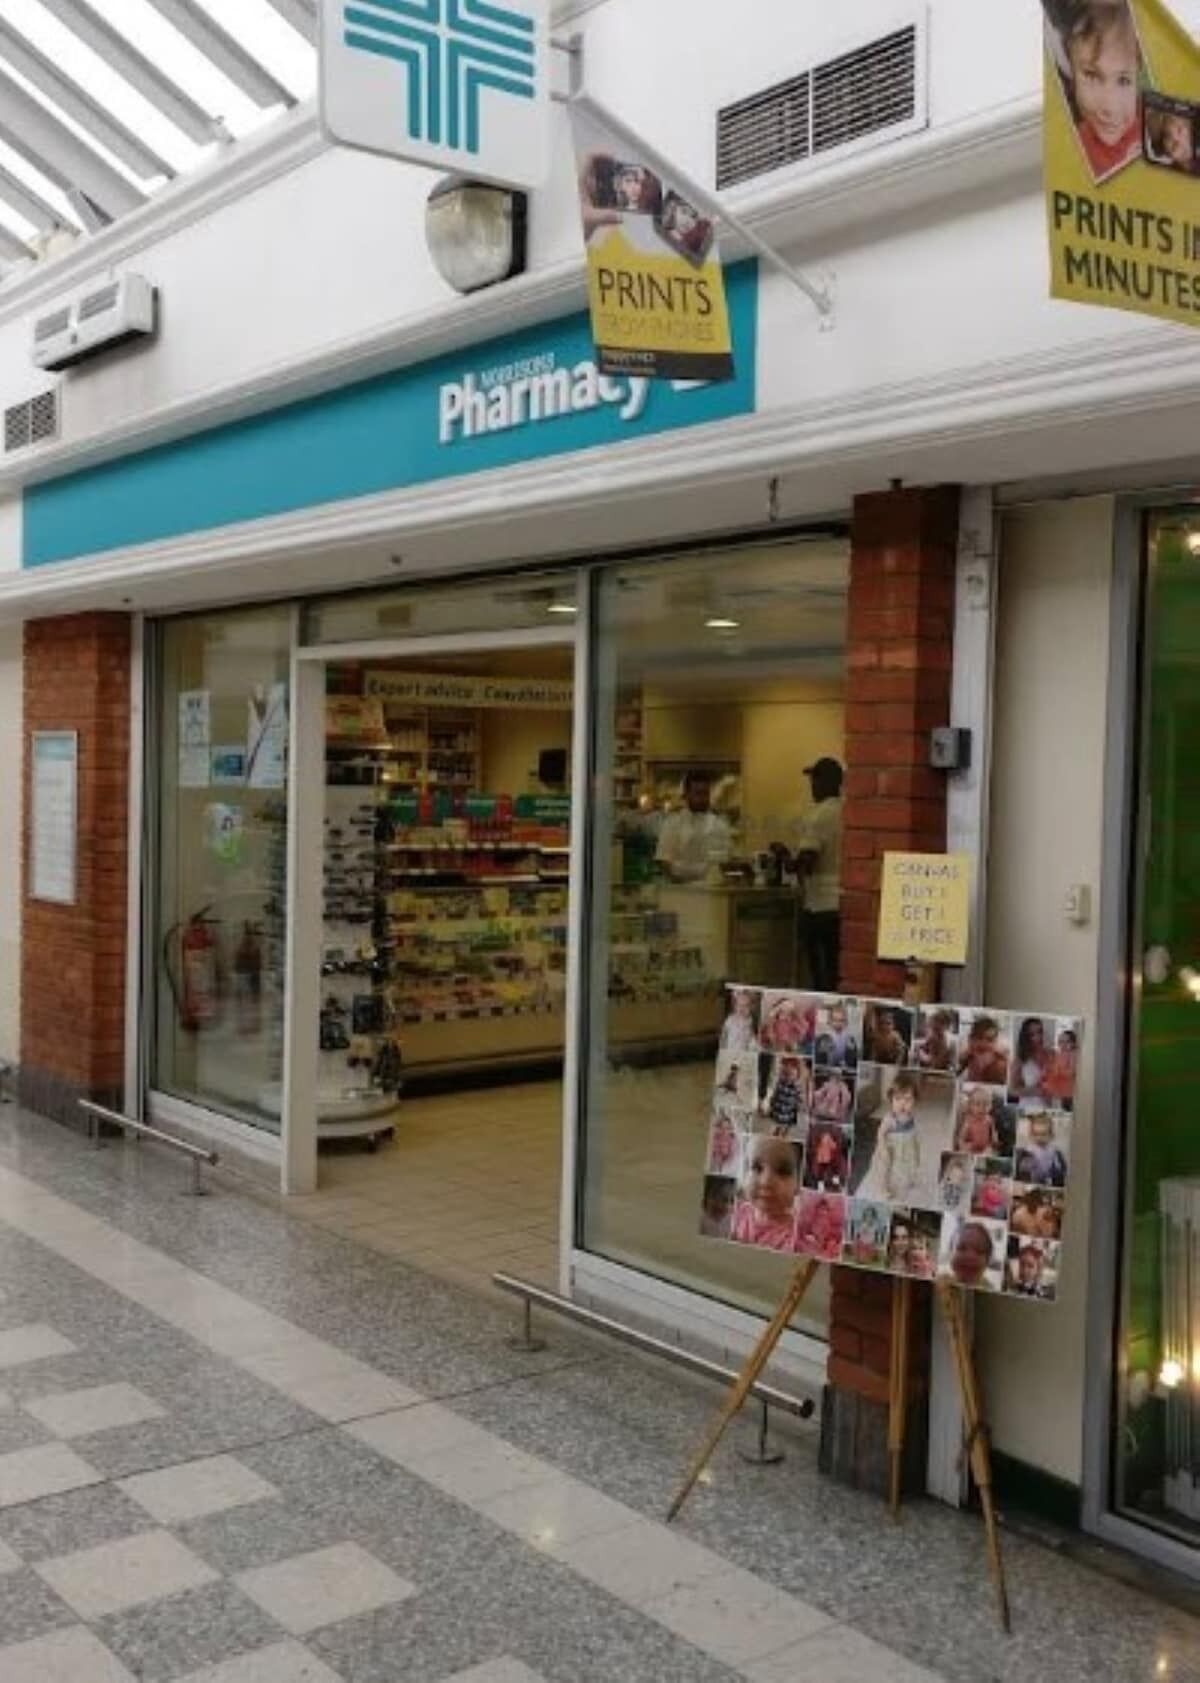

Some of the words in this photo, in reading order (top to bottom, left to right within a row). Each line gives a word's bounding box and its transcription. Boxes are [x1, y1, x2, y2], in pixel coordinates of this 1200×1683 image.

[1052, 189, 1173, 254] PRINTS
[597, 266, 713, 317] PRINTS
[1063, 246, 1200, 312] MINUTES
[901, 904, 935, 920] GET
